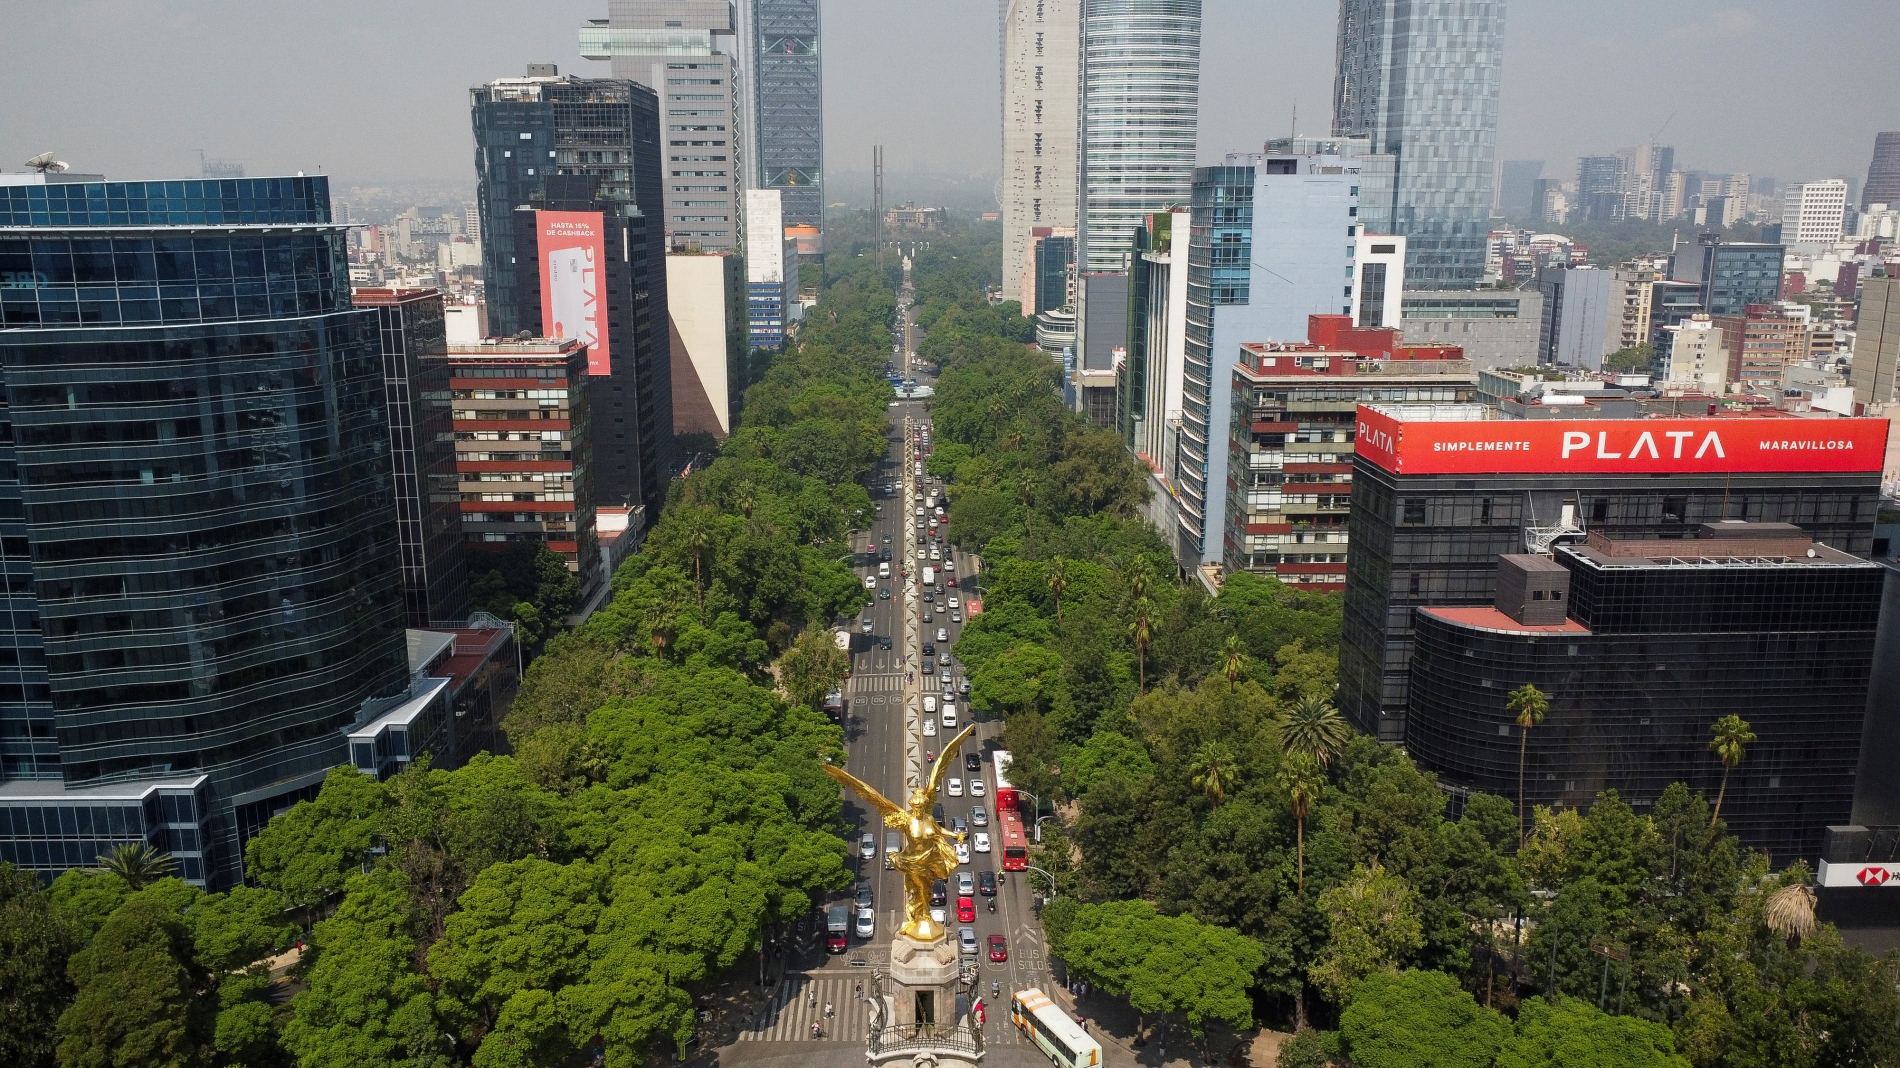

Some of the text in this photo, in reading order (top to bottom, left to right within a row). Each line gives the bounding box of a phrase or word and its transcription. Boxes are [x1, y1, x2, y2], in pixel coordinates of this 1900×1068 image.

[581, 245, 599, 348] PLATA
[1359, 421, 1854, 459] PLATA SIMPLEMENTE PLATA MARAVILLOSA
[1018, 960, 1044, 971] SOLO
[1019, 949, 1040, 959] BUS
